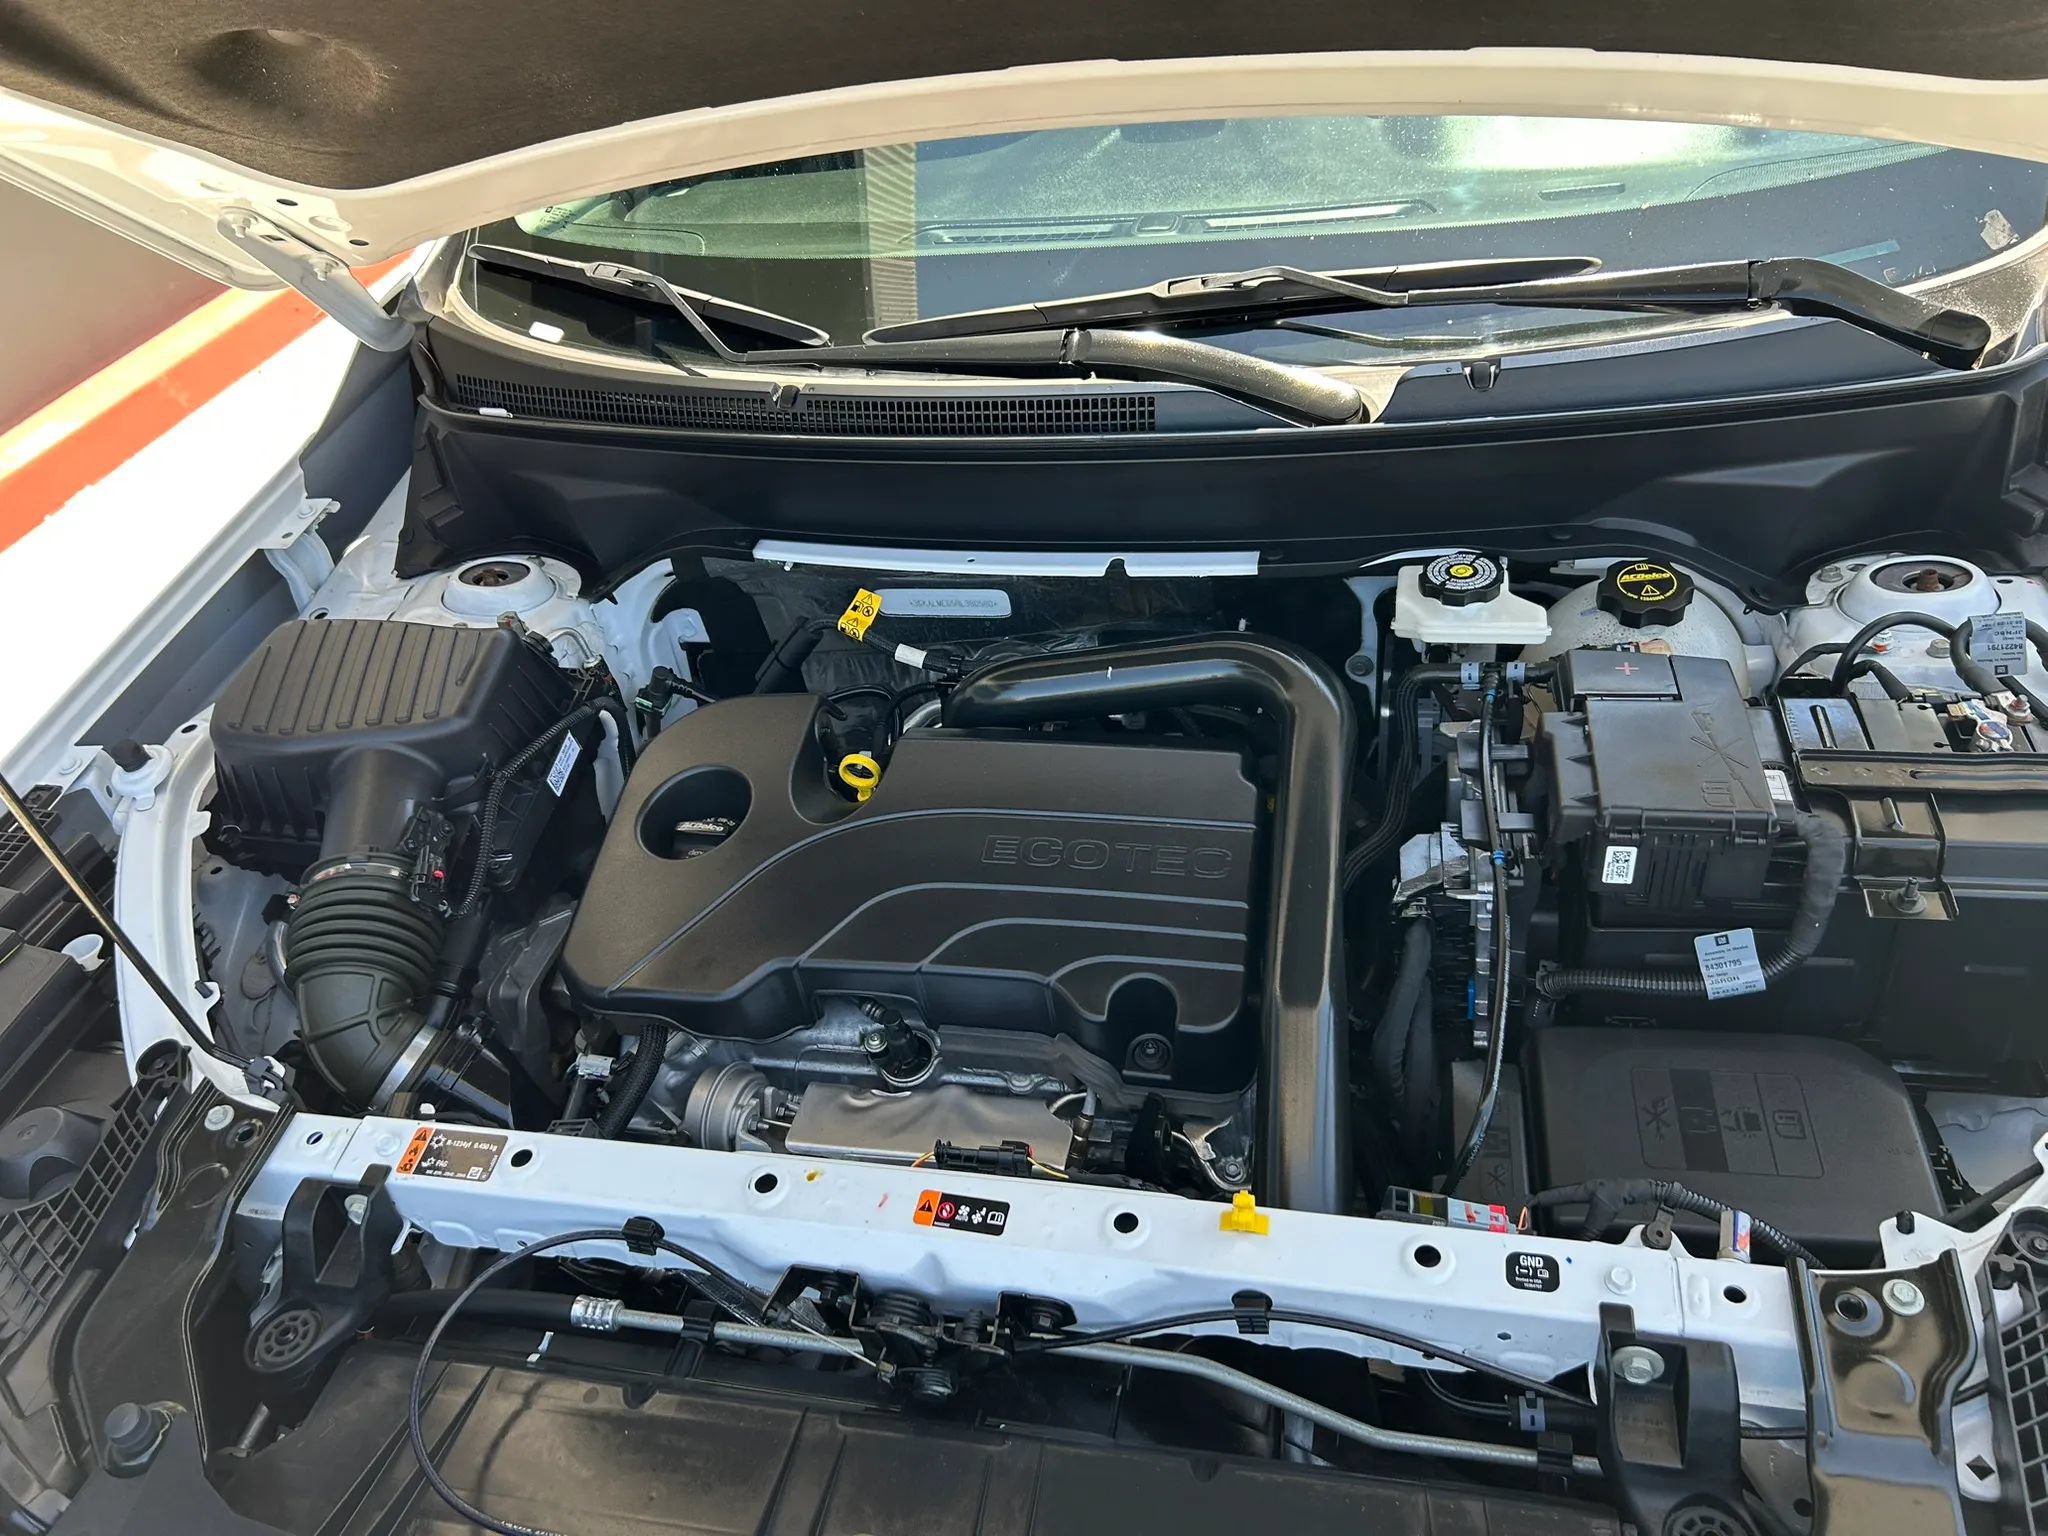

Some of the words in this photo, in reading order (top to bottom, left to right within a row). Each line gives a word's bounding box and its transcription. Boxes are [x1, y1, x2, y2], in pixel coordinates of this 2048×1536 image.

[1620, 572, 1671, 582] ACDelco
[981, 835, 1233, 879] ECOTEC
[1704, 959, 1743, 972] 84301795
[1519, 1254, 1544, 1269] GND
